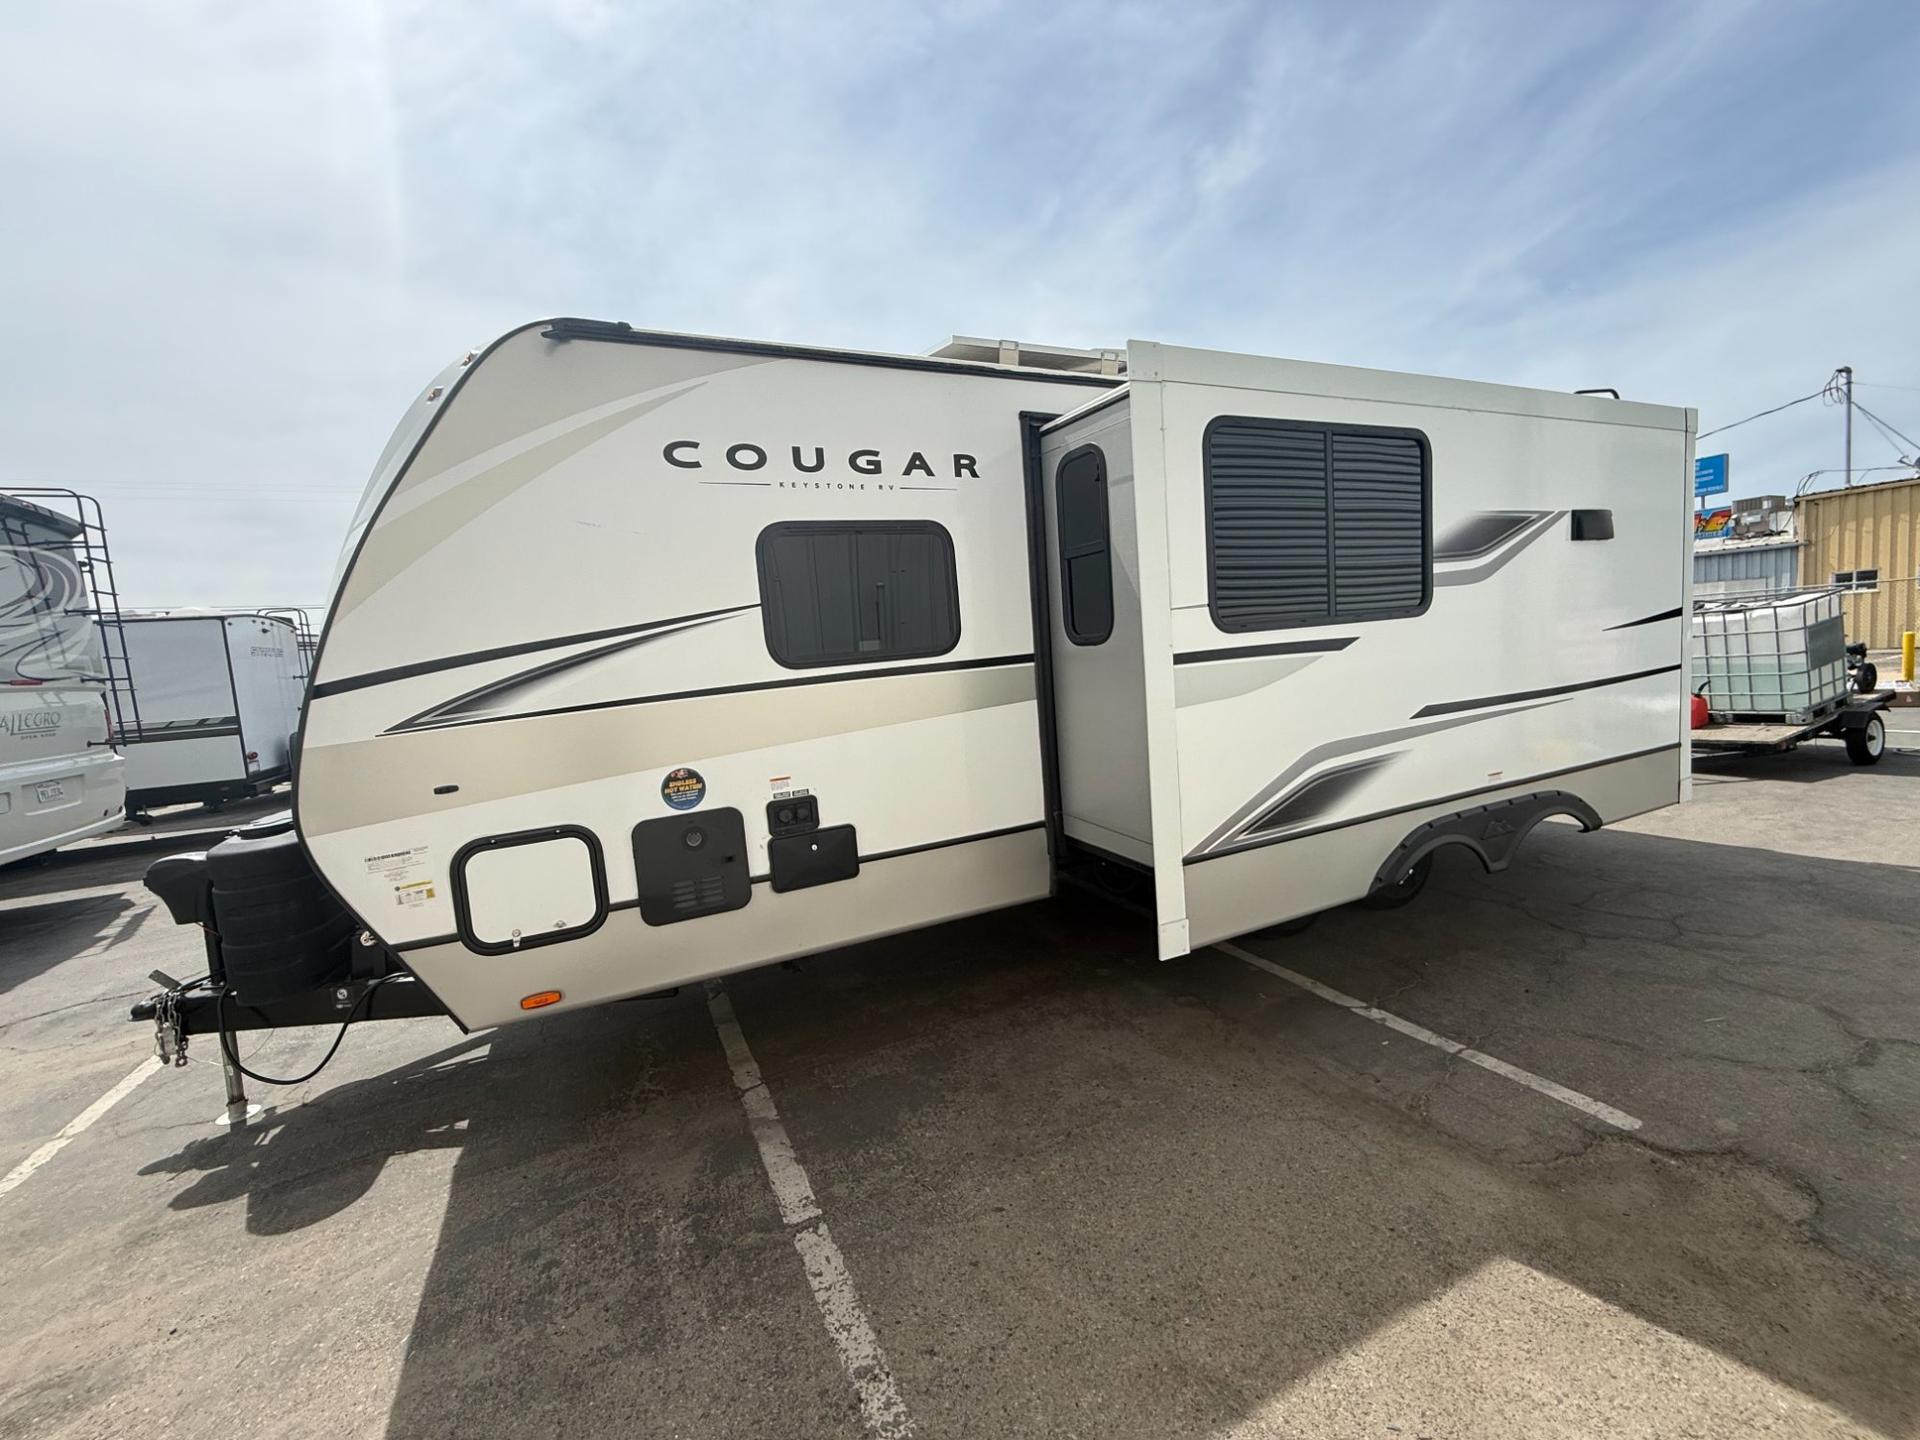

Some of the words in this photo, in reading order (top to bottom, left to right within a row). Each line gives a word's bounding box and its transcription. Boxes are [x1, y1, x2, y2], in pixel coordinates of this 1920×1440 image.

[662, 440, 981, 478] COUGAR
[779, 481, 865, 491] KEYSTONE
[0, 711, 61, 736] ALLEGRO
